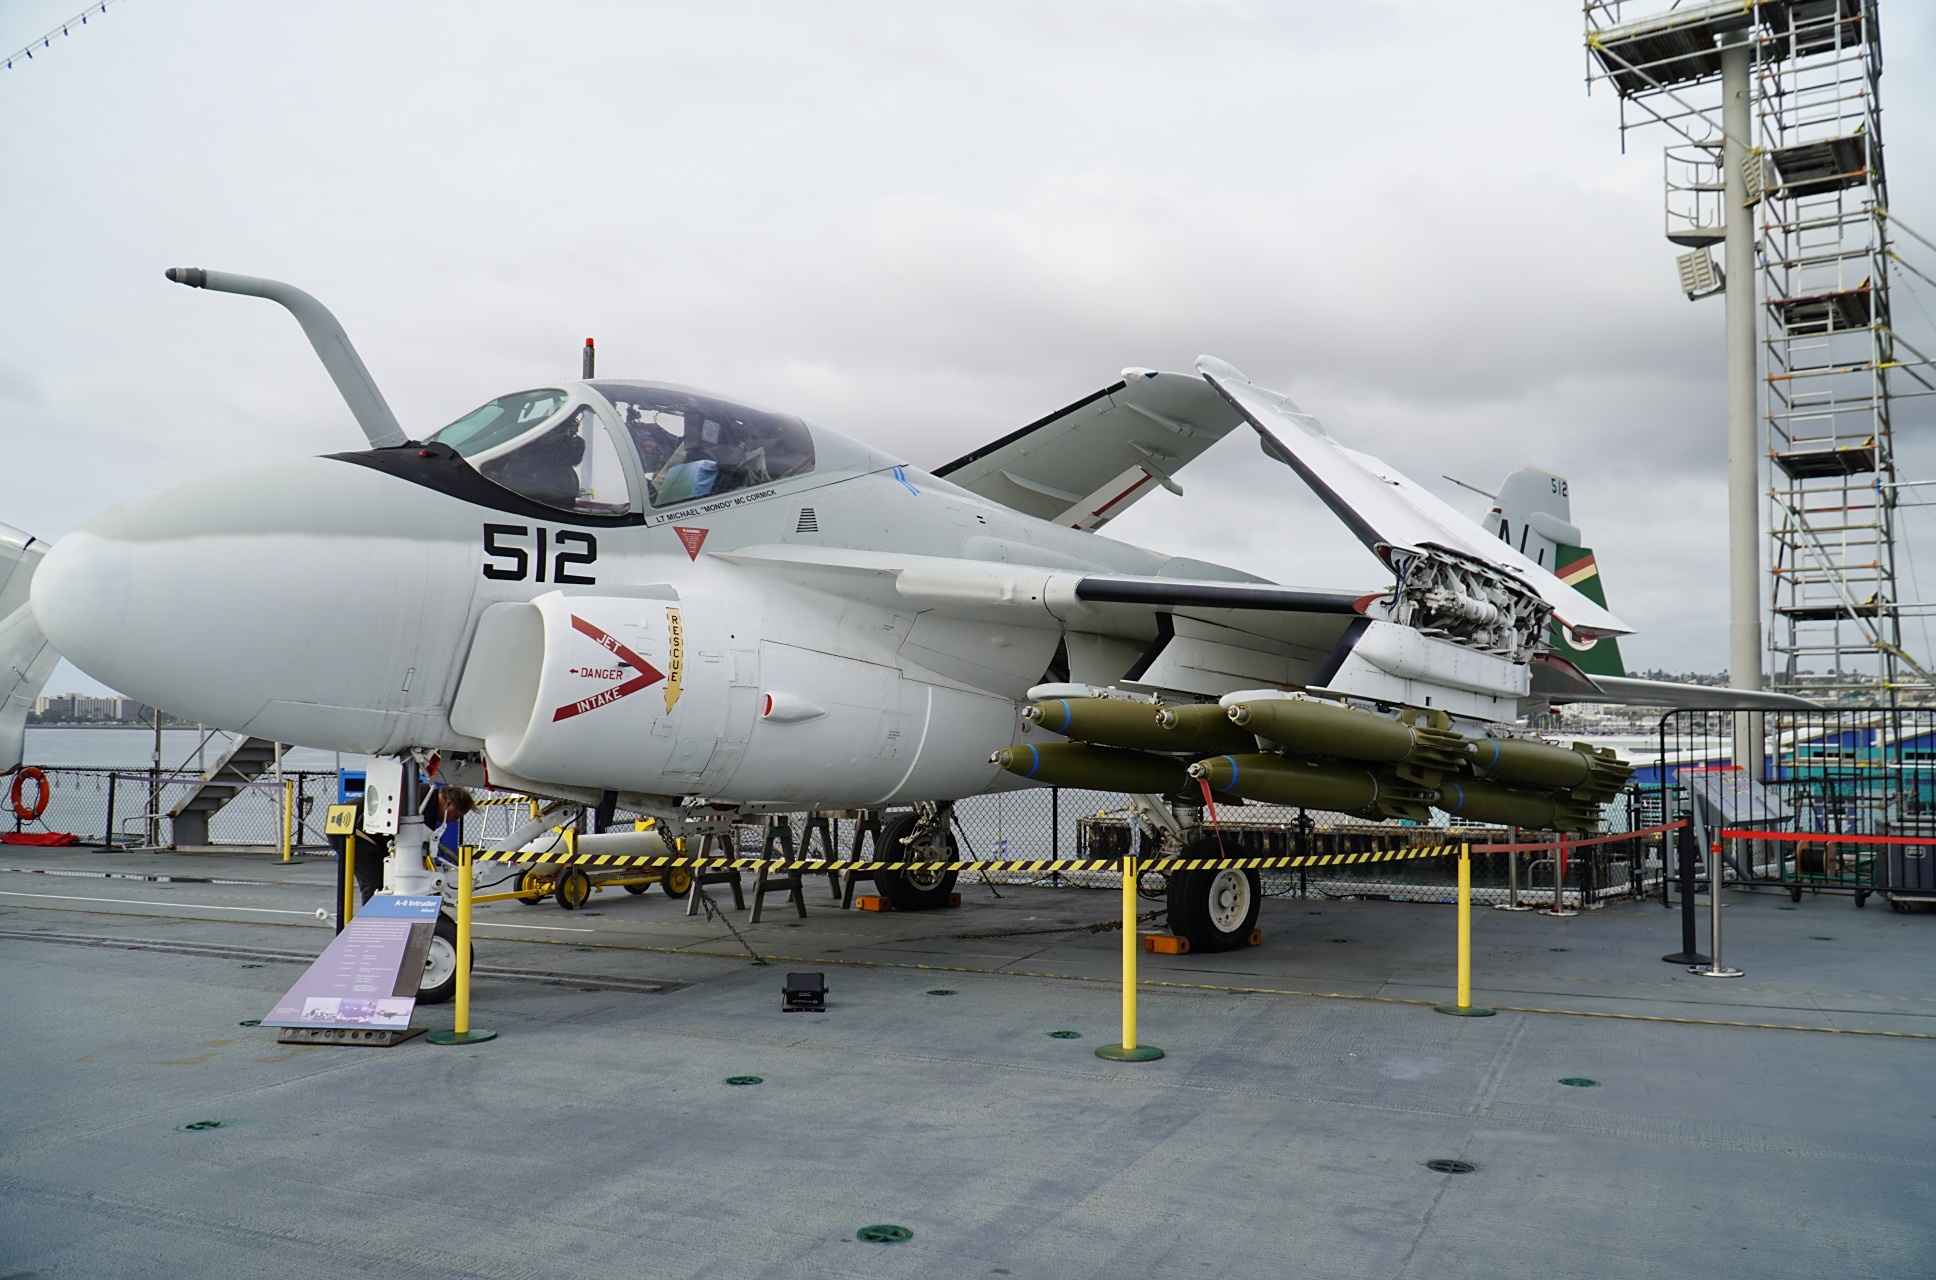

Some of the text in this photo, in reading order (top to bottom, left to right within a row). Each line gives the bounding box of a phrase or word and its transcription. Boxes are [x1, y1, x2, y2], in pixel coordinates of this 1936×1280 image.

[1551, 477, 1568, 497] 512
[656, 489, 777, 523] LT MICHAEL "MONDO" MC CORMICK
[483, 523, 597, 585] 512
[596, 634, 622, 653] JET
[671, 615, 680, 682] RESCUE
[580, 667, 624, 680] DANGER
[576, 687, 623, 713] INTAKE
[394, 899, 437, 907] A-6 Intruder
